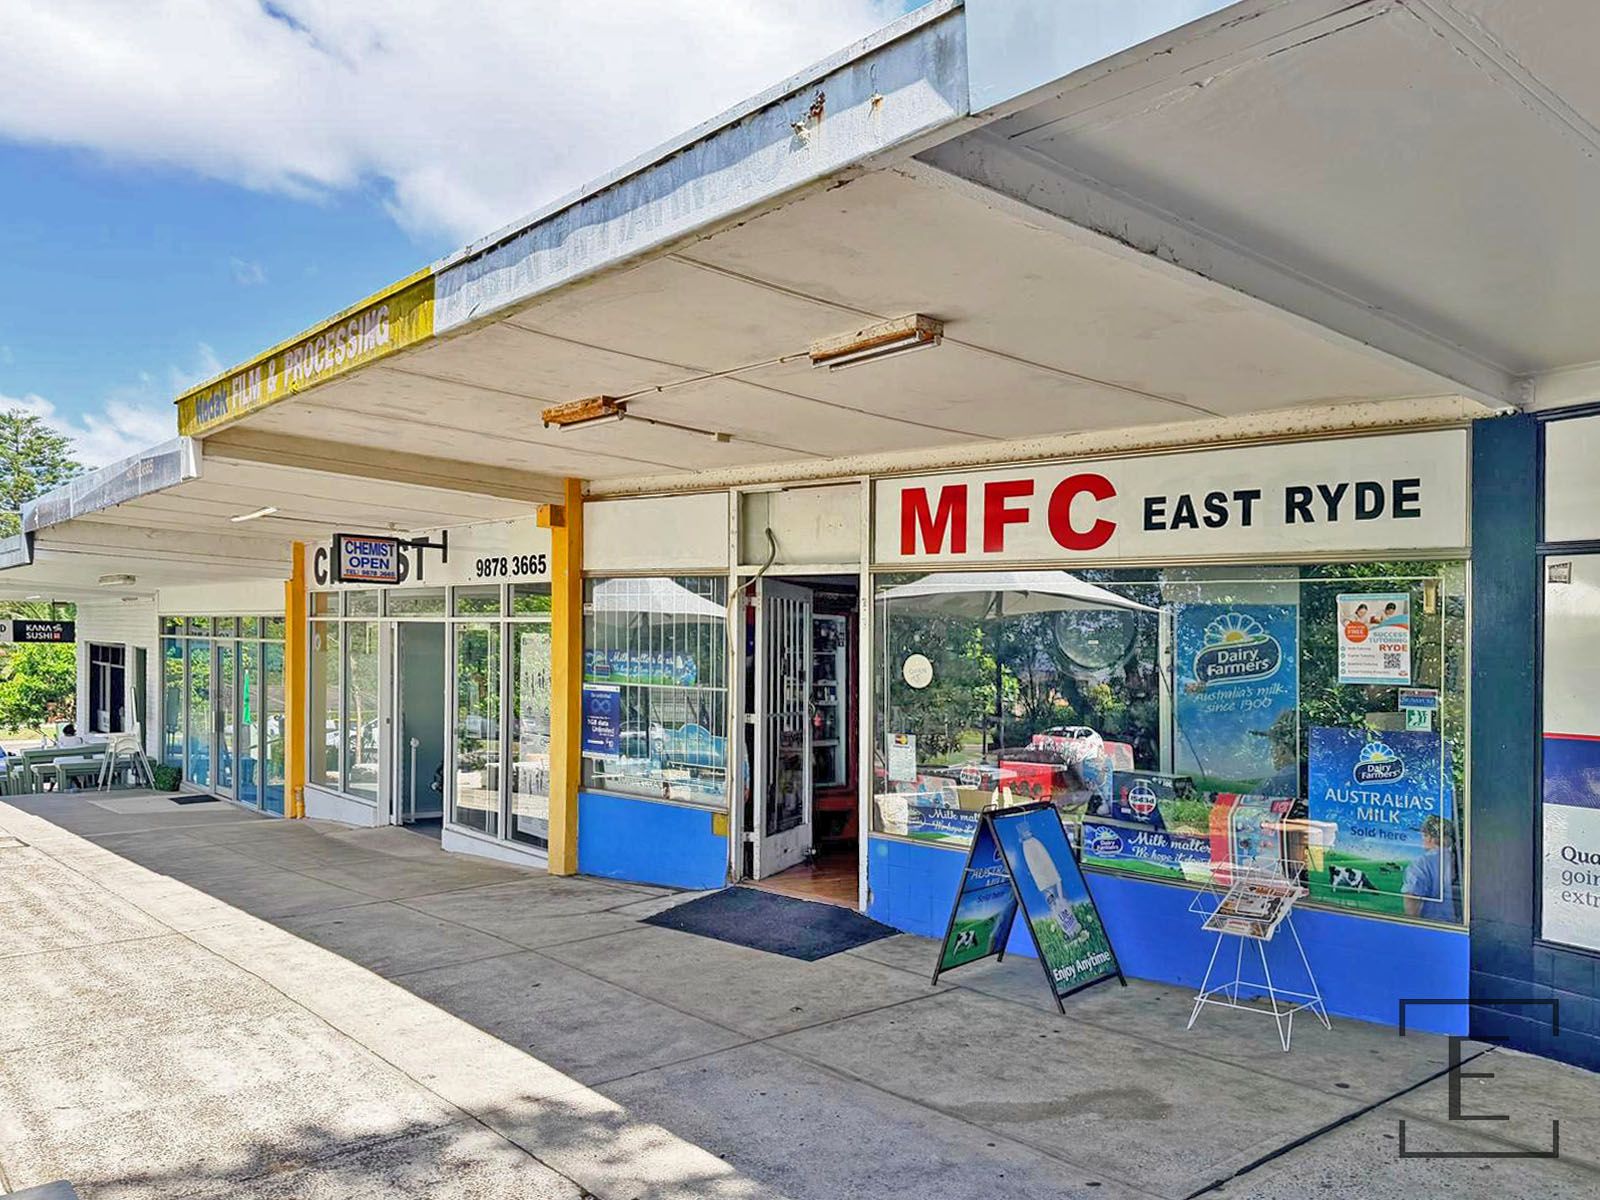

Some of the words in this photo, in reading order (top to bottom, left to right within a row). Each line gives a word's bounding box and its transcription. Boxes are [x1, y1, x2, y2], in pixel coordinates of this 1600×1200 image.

[232, 366, 261, 409] FILM
[268, 359, 278, 394] &
[284, 305, 389, 387] PROCESSING
[900, 473, 1117, 556] MFC
[1143, 489, 1261, 531] EAST
[1286, 478, 1421, 524] RYDE
[345, 540, 395, 557] CHEMIST
[349, 556, 390, 570] OPEN
[476, 557, 508, 578] 9878
[512, 554, 547, 575] 3665
[25, 624, 52, 632] KANA
[1217, 648, 1260, 663] Dairy
[1379, 644, 1408, 652] RYDE
[1207, 658, 1270, 676] Farmers
[1204, 701, 1235, 713] since
[1240, 697, 1272, 712] 1900
[1361, 770, 1399, 779] Farmers
[1367, 764, 1392, 773] Dairy
[1325, 788, 1434, 811] AUSTRALIA'S
[928, 808, 958, 821] Milk
[1357, 807, 1400, 824] MILK
[1128, 831, 1168, 848] Milk
[1350, 825, 1376, 838] Sold
[1380, 828, 1407, 841] here
[1132, 846, 1149, 858] We
[1052, 964, 1076, 982] Enjoy
[1075, 951, 1111, 973] Anytime
